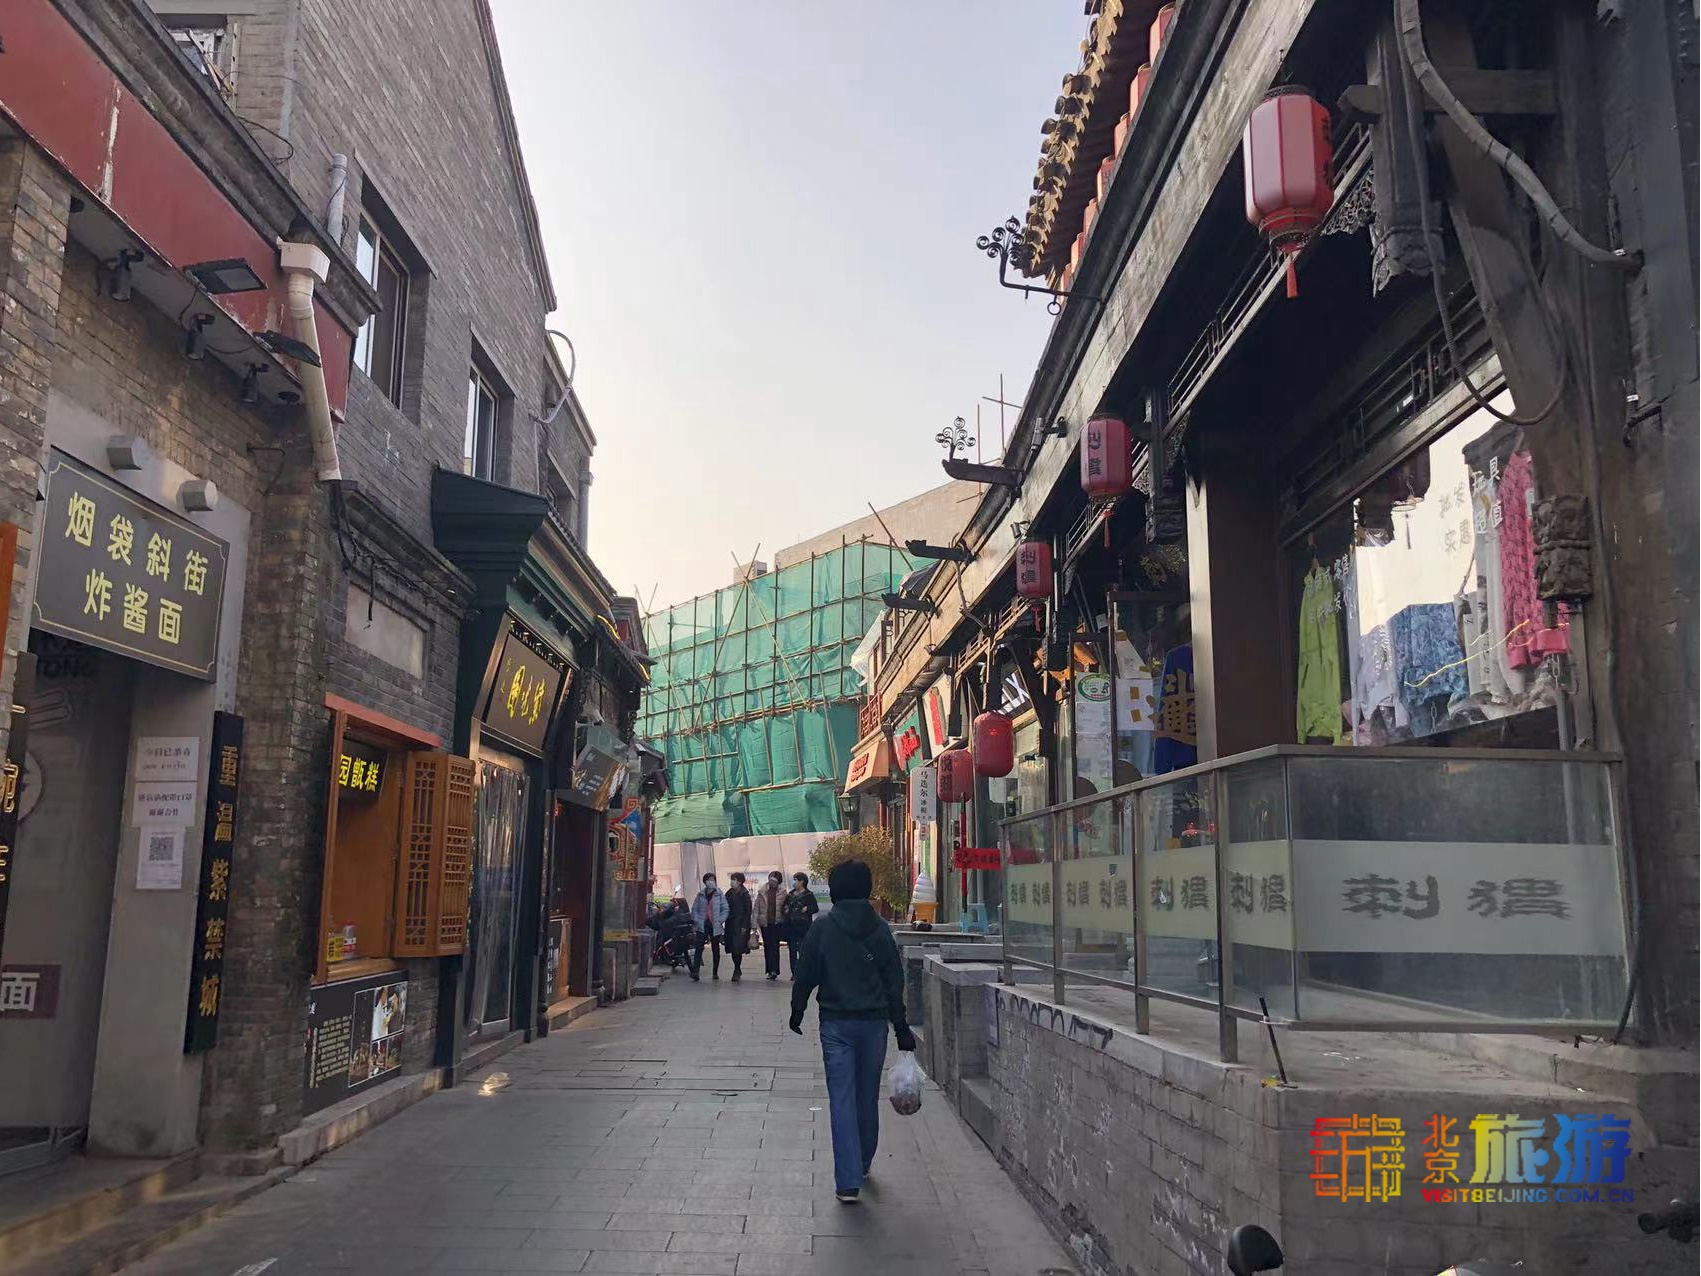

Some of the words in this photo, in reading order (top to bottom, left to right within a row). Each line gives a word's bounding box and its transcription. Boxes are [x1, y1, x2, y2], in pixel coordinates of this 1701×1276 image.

[64, 491, 209, 596] 烟袋斜街
[83, 567, 183, 645] 炸酱面
[0, 971, 40, 1012] 面
